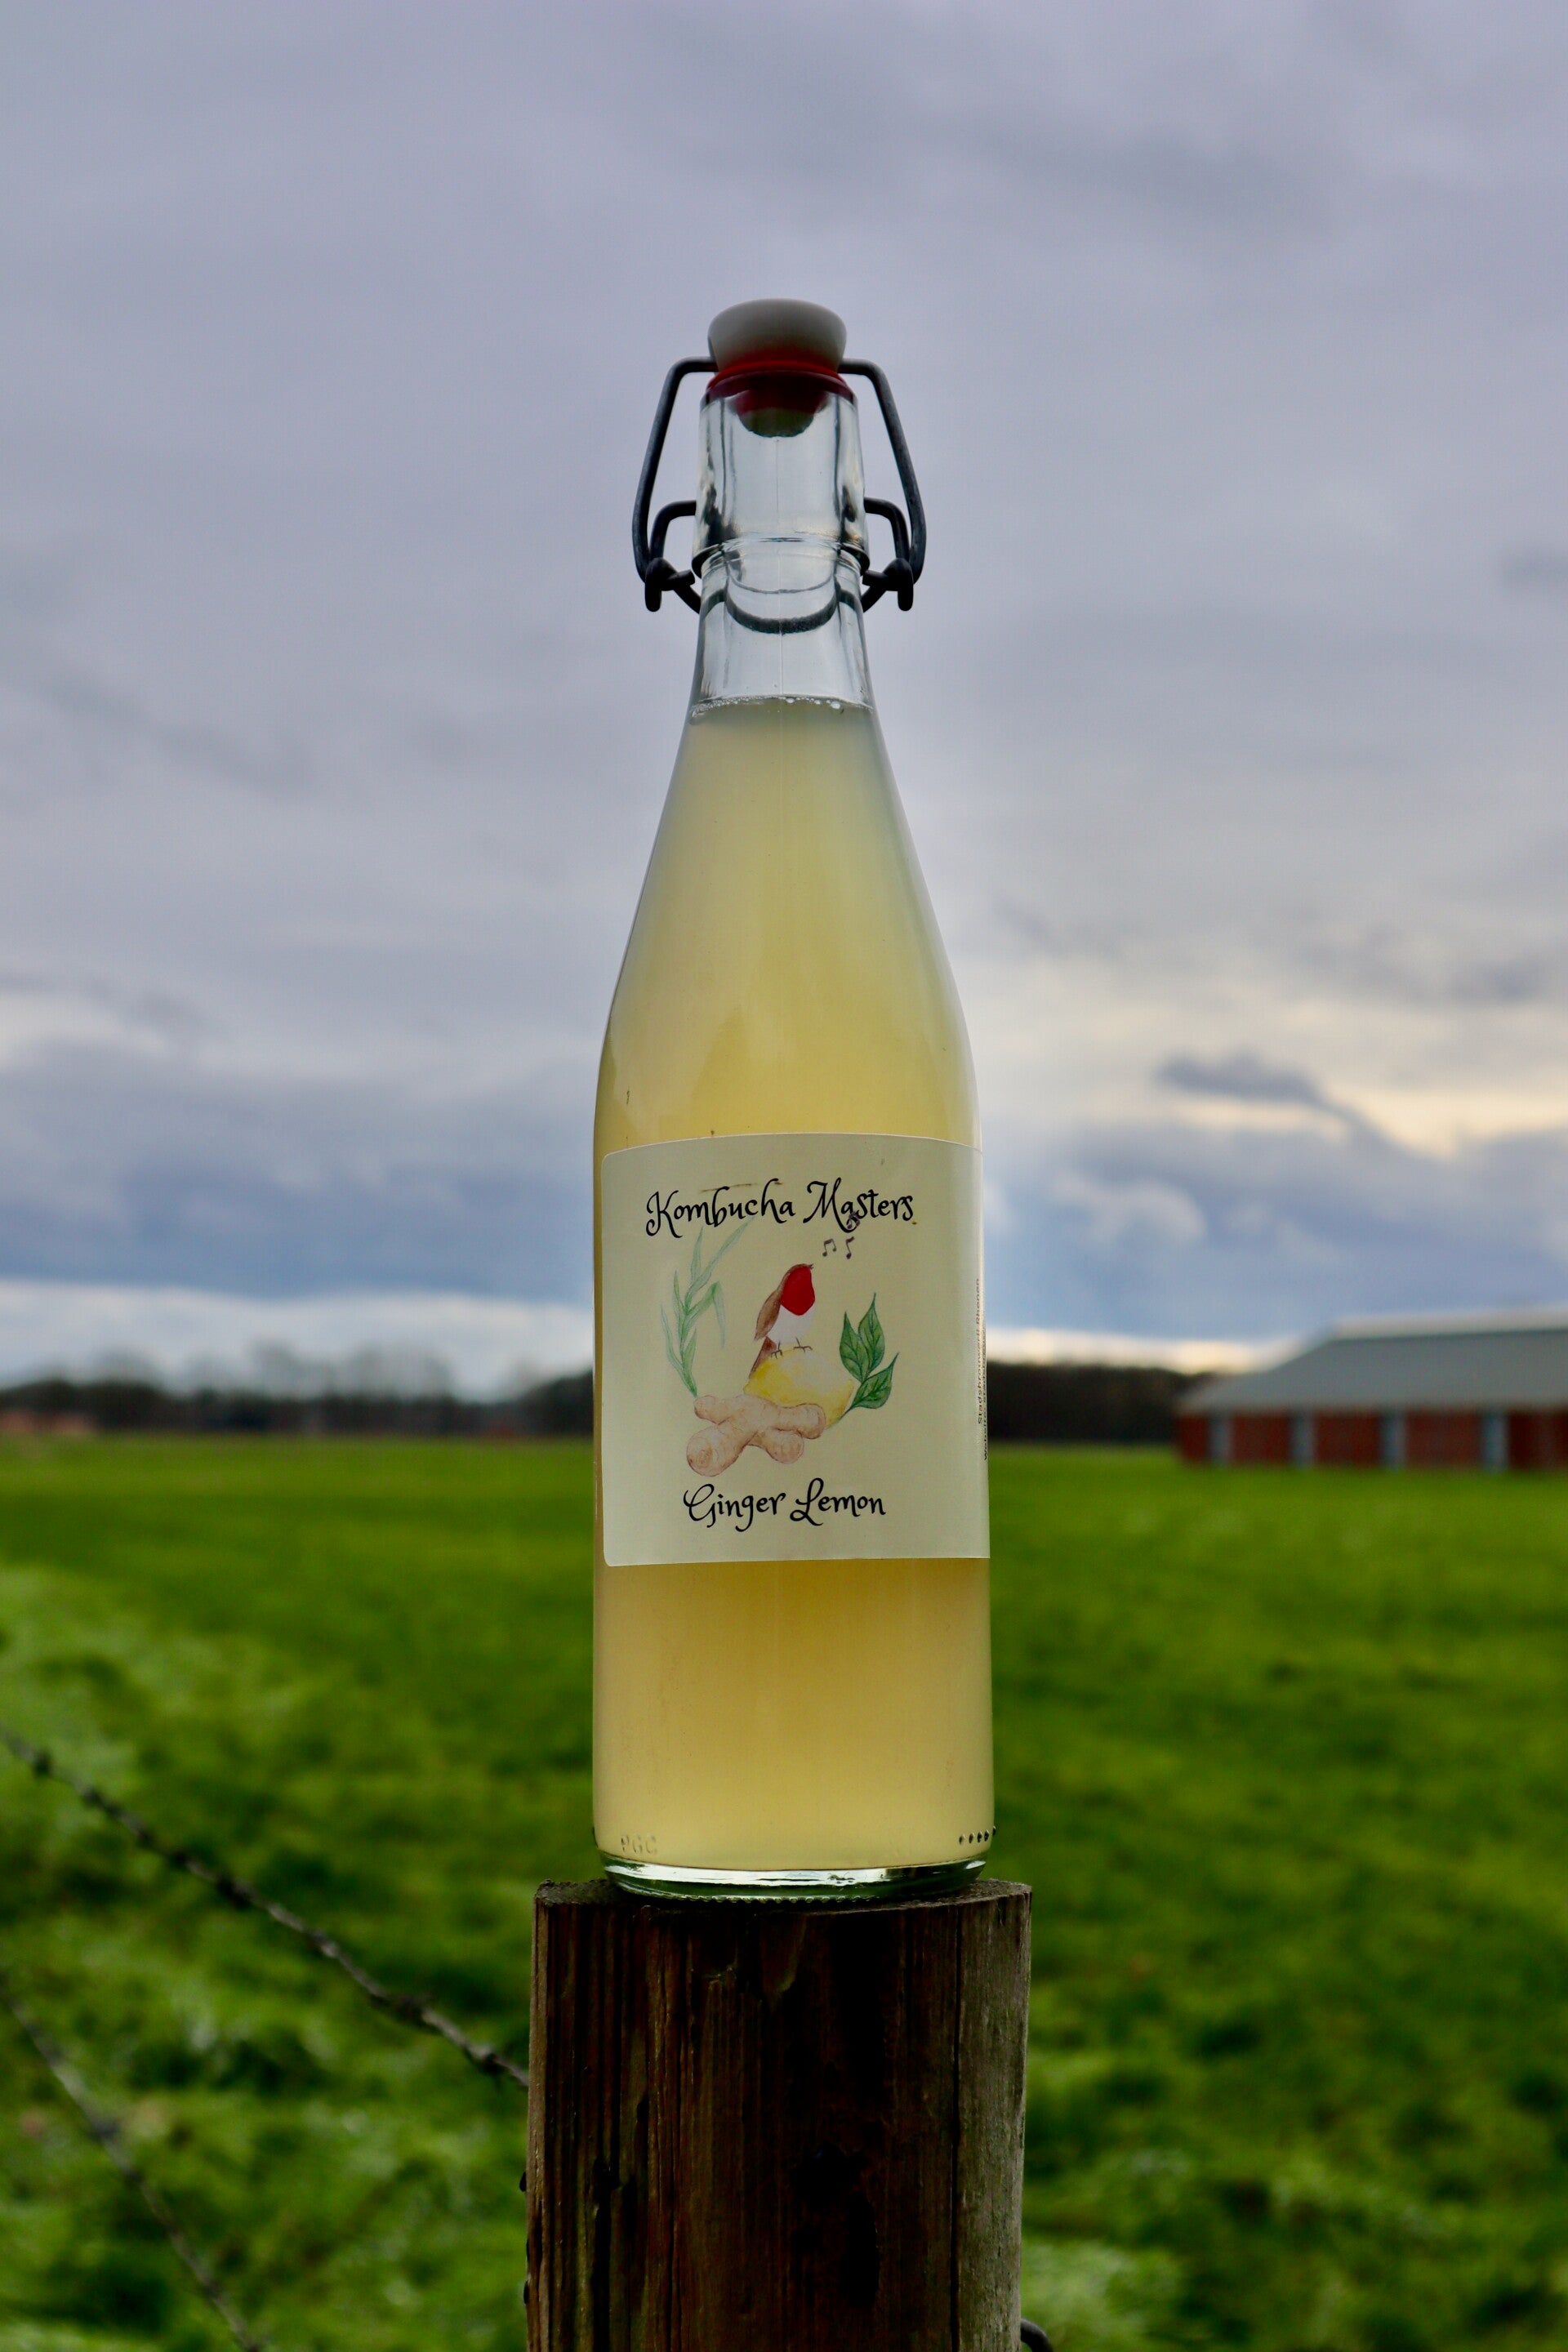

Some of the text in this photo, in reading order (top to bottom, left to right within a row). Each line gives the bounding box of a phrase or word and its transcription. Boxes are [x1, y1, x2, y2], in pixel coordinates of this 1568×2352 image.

[645, 1178, 914, 1238] Kombucha Masters
[683, 1477, 886, 1532] Ginger Lemon
